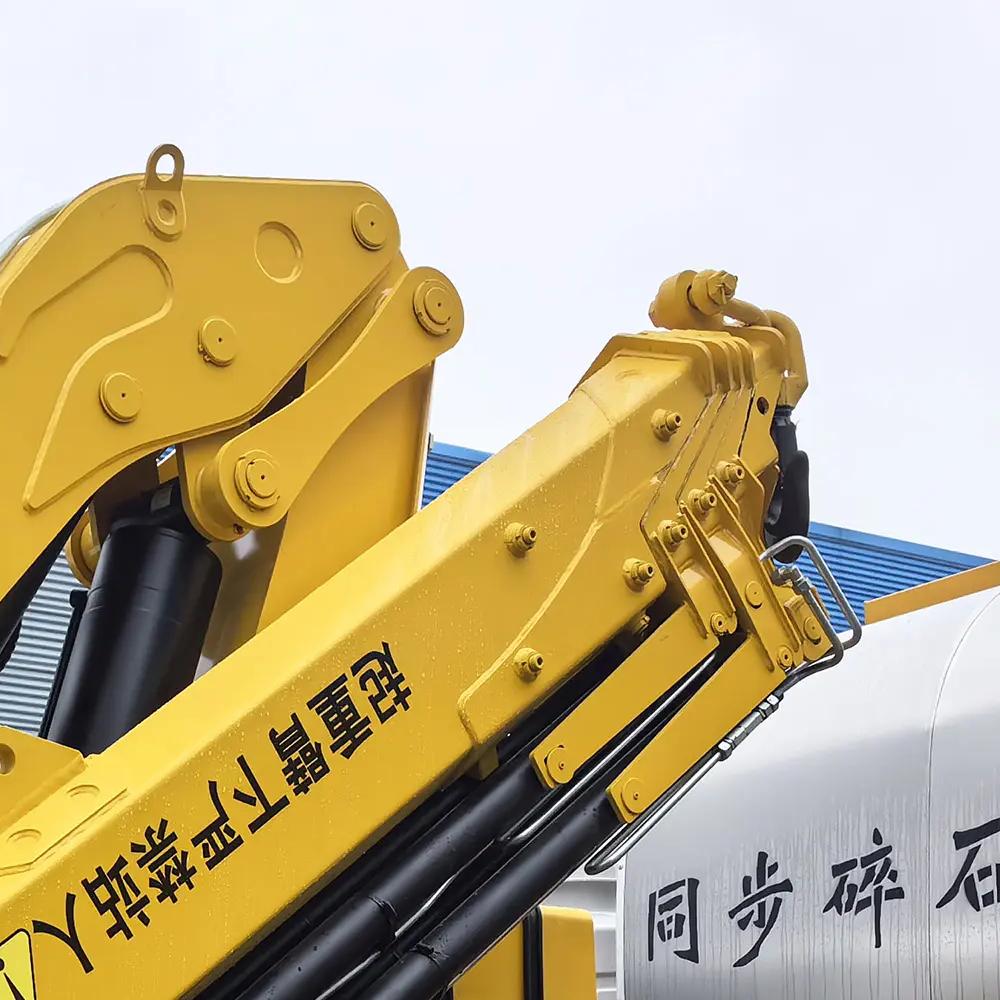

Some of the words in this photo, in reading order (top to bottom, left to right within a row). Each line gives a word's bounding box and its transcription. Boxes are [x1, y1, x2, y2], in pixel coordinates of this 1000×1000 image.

[31, 641, 412, 974] 起重臂下严禁站人
[647, 817, 1000, 968] 同步碎石
